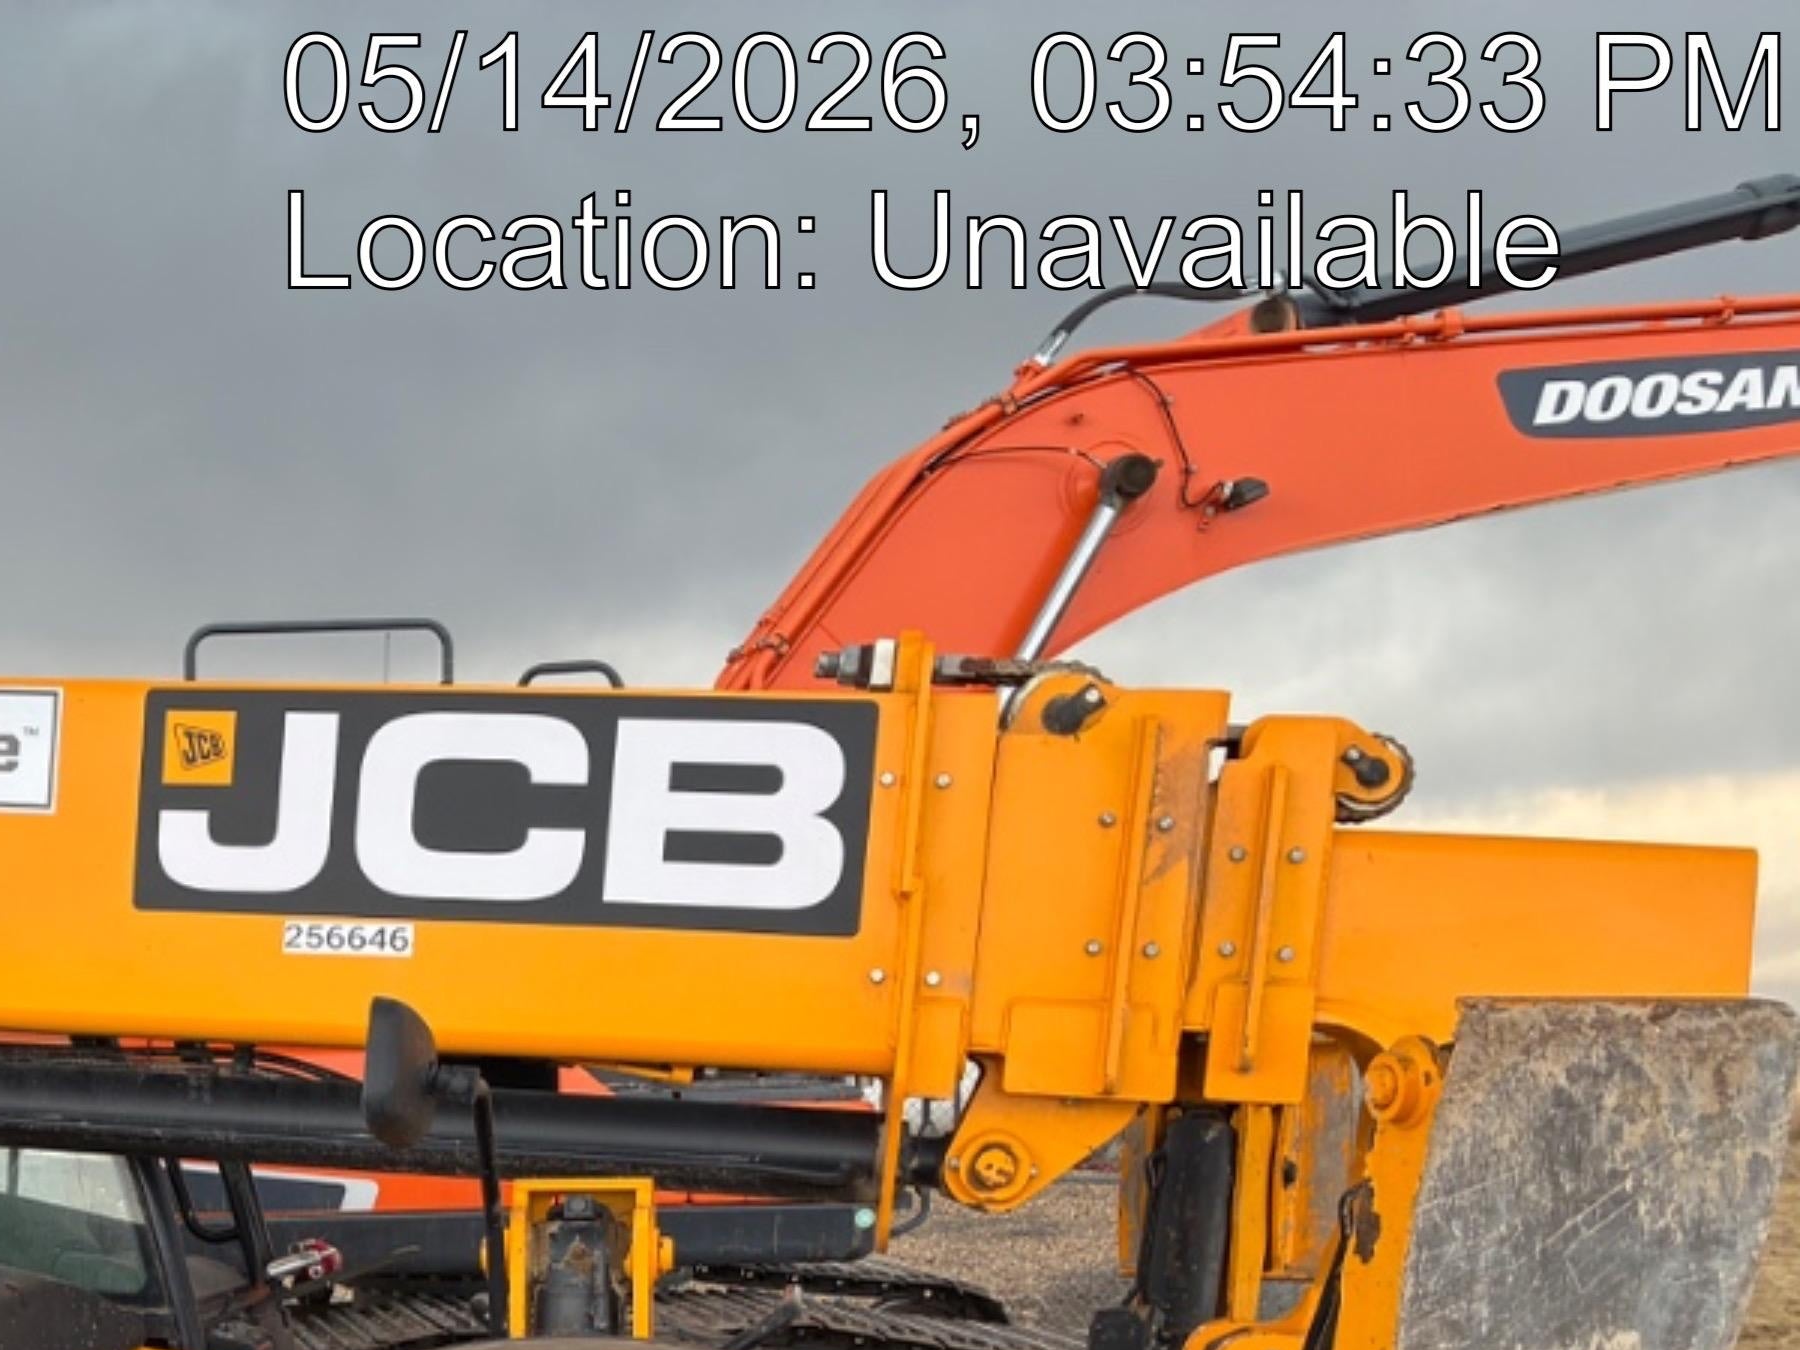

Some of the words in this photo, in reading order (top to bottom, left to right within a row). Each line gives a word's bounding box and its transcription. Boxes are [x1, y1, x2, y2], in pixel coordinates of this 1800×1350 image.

[1532, 364, 1800, 426] DOOSAN
[157, 710, 847, 911] JCB
[285, 924, 409, 952] 256646
